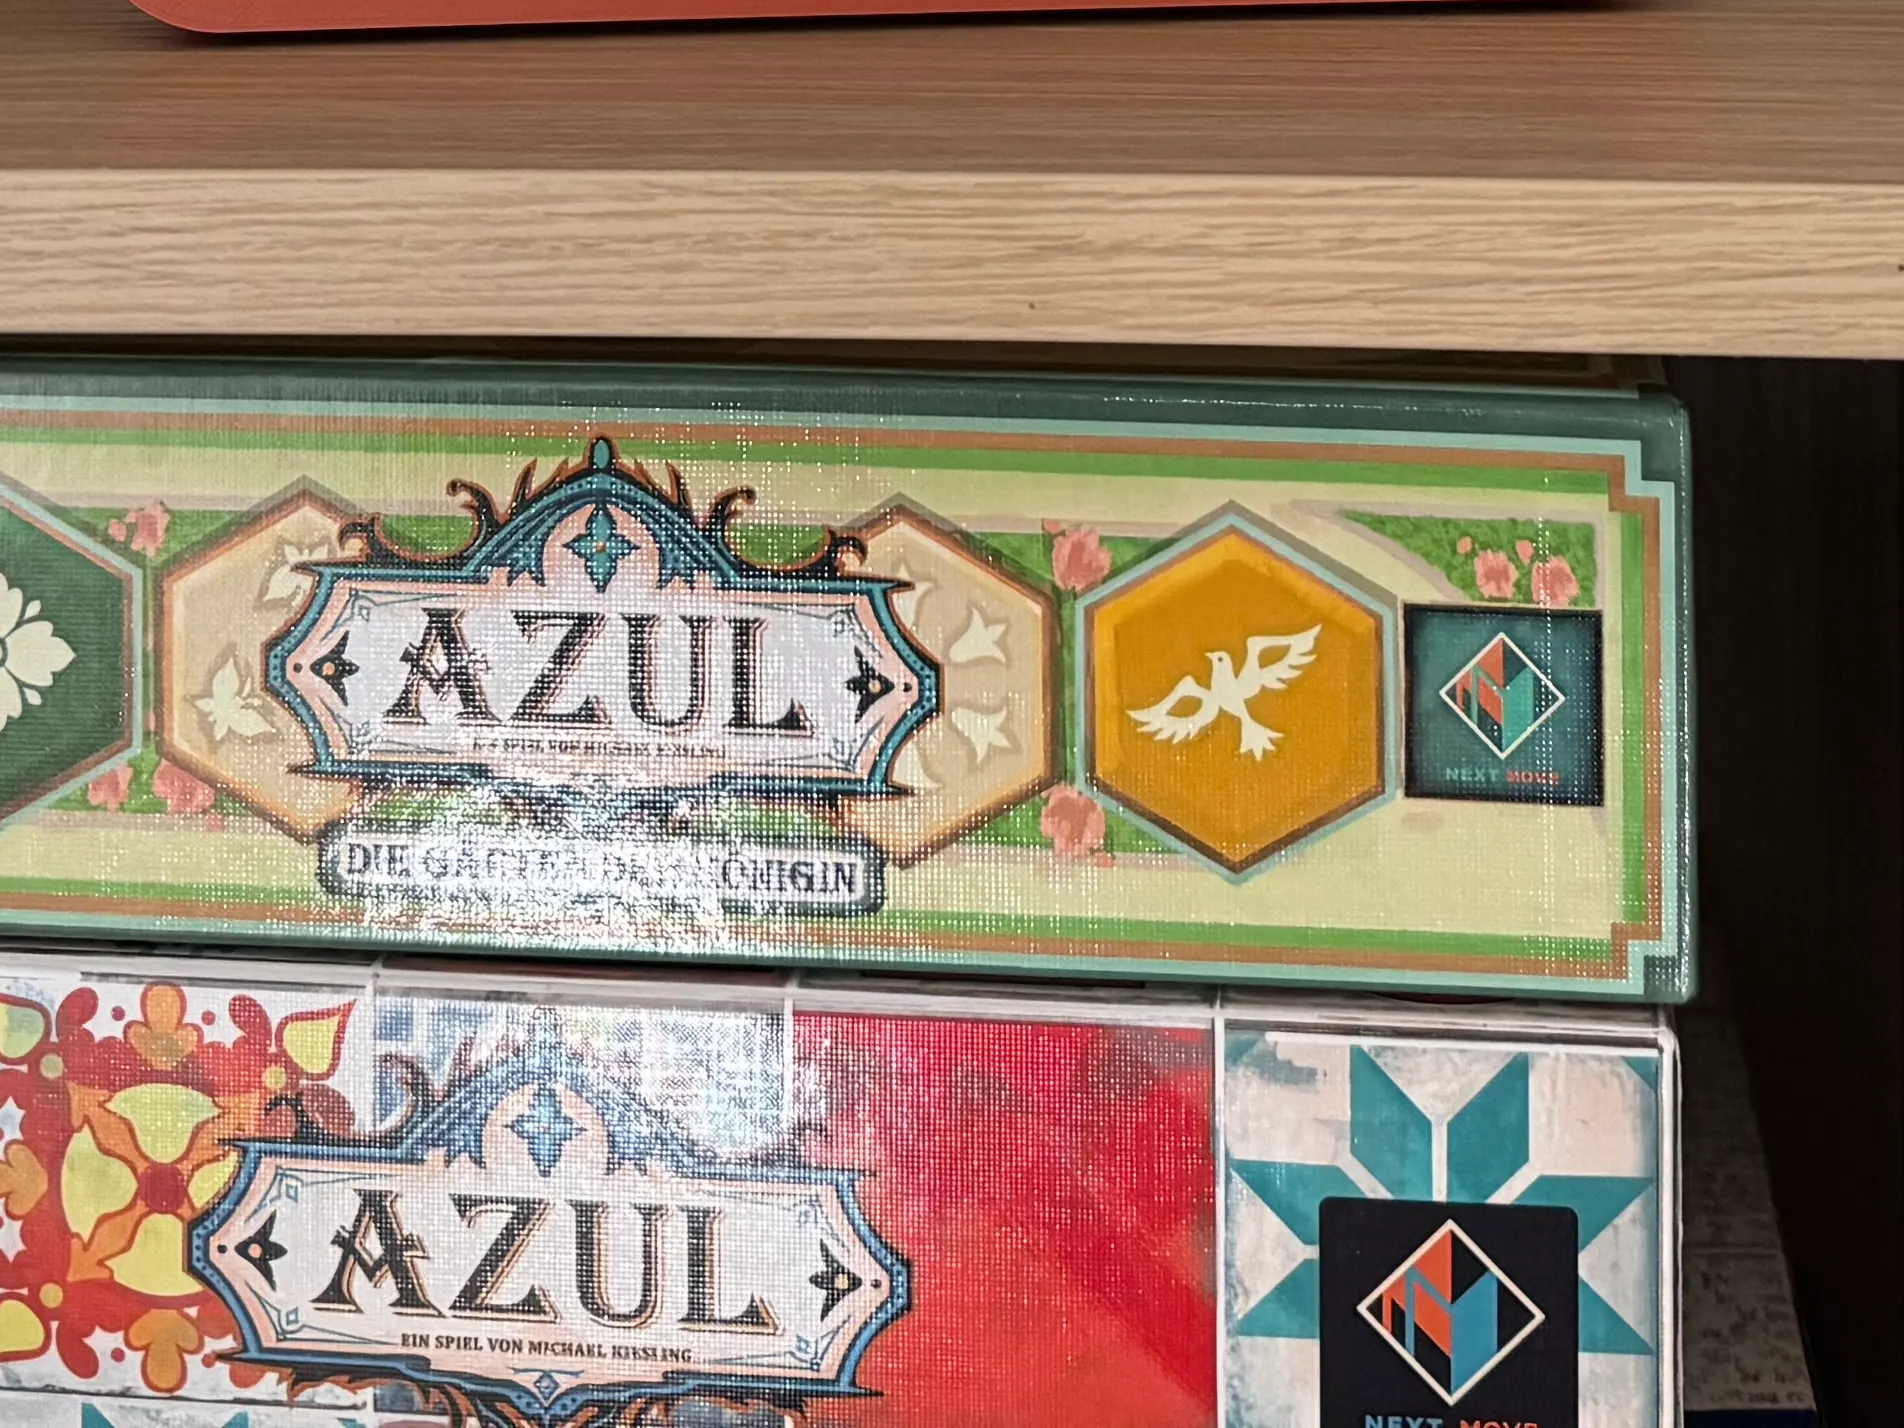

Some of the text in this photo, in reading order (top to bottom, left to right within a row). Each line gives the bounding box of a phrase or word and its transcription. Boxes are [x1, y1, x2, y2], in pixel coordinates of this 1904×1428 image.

[383, 607, 811, 736] AZUL
[1444, 766, 1501, 782] NEXT
[310, 1188, 780, 1334] AZUL
[400, 1331, 430, 1349] EIN
[434, 1333, 484, 1352] SPIEL
[487, 1336, 525, 1354] VON
[527, 1339, 608, 1360] MICHAEL
